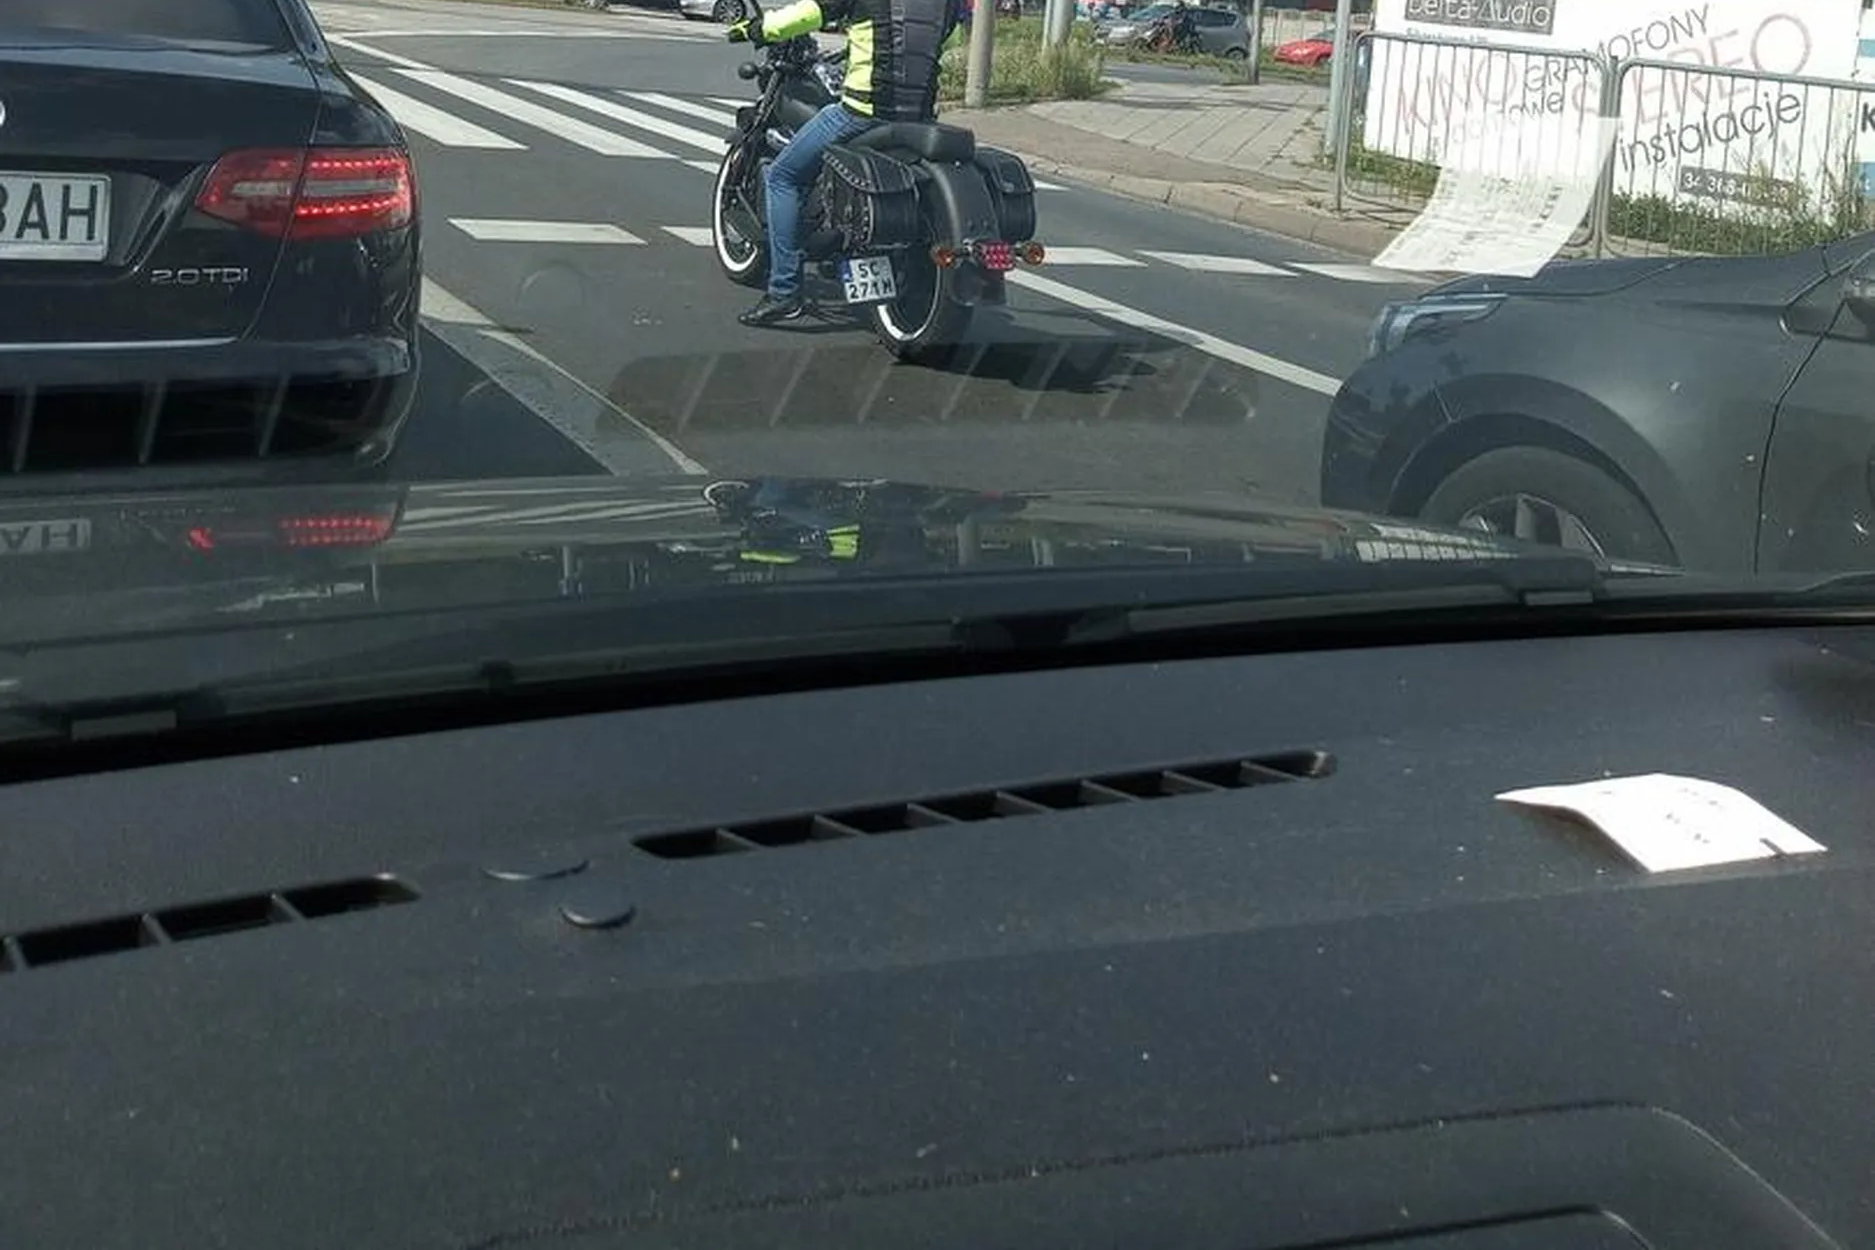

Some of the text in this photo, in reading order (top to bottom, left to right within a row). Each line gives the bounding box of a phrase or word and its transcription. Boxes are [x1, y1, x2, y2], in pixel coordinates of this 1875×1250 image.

[1571, 13, 1813, 125] SEREO
[1618, 91, 1801, 172] instalacje
[858, 261, 880, 278] SC
